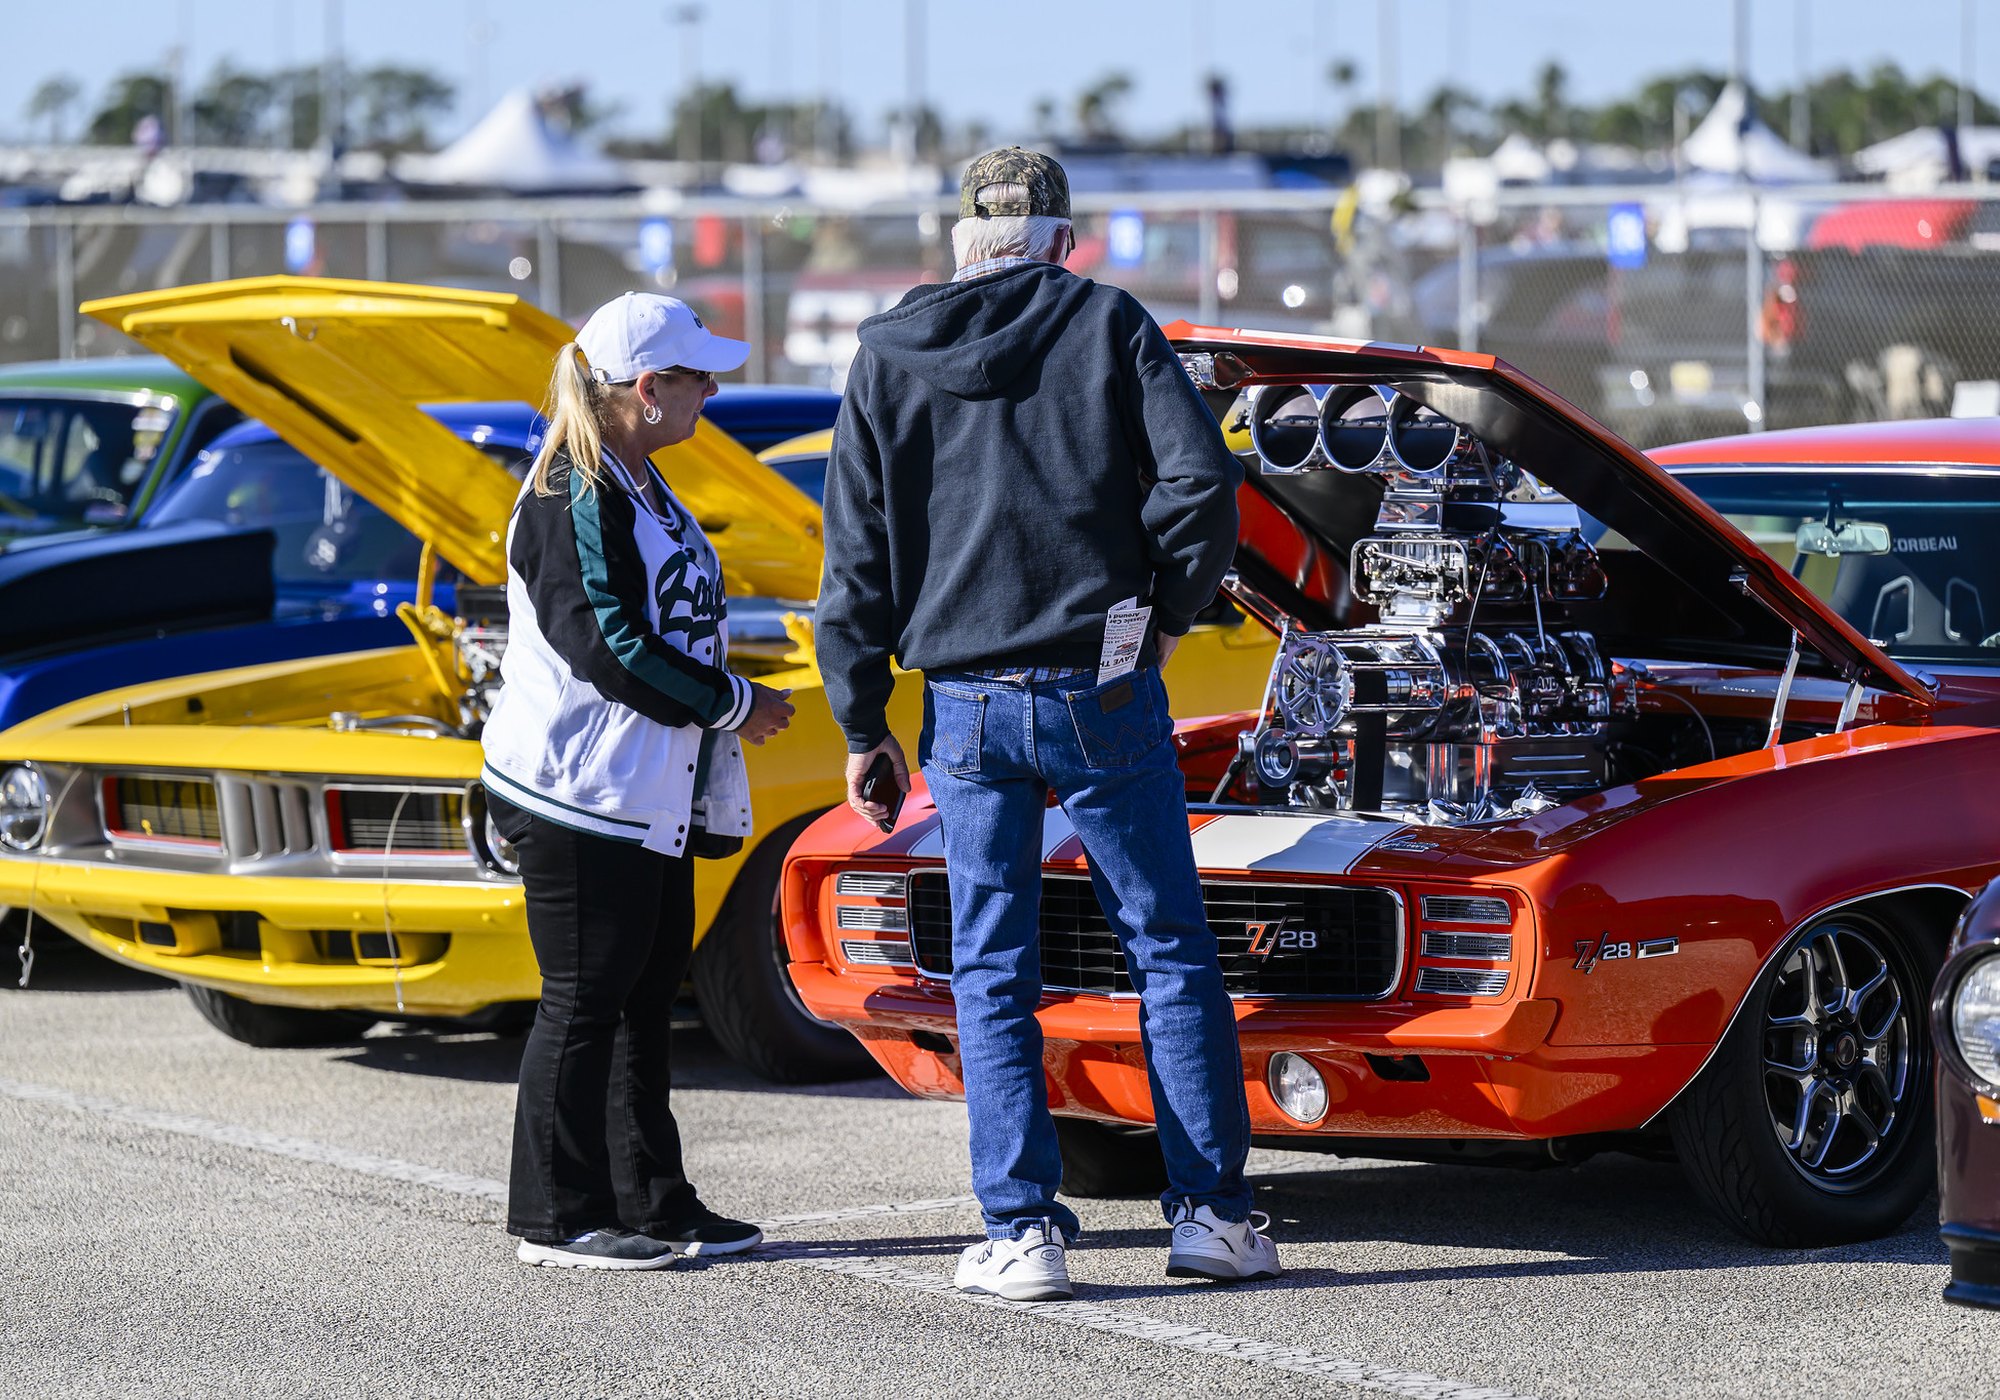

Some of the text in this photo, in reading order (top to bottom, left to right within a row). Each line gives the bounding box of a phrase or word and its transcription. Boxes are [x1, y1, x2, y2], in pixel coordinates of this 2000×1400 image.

[1123, 615, 1146, 624] Classic
[1113, 653, 1135, 666] SAVE
[1245, 915, 1318, 963] Z/28
[1574, 930, 1632, 975] Z/28
